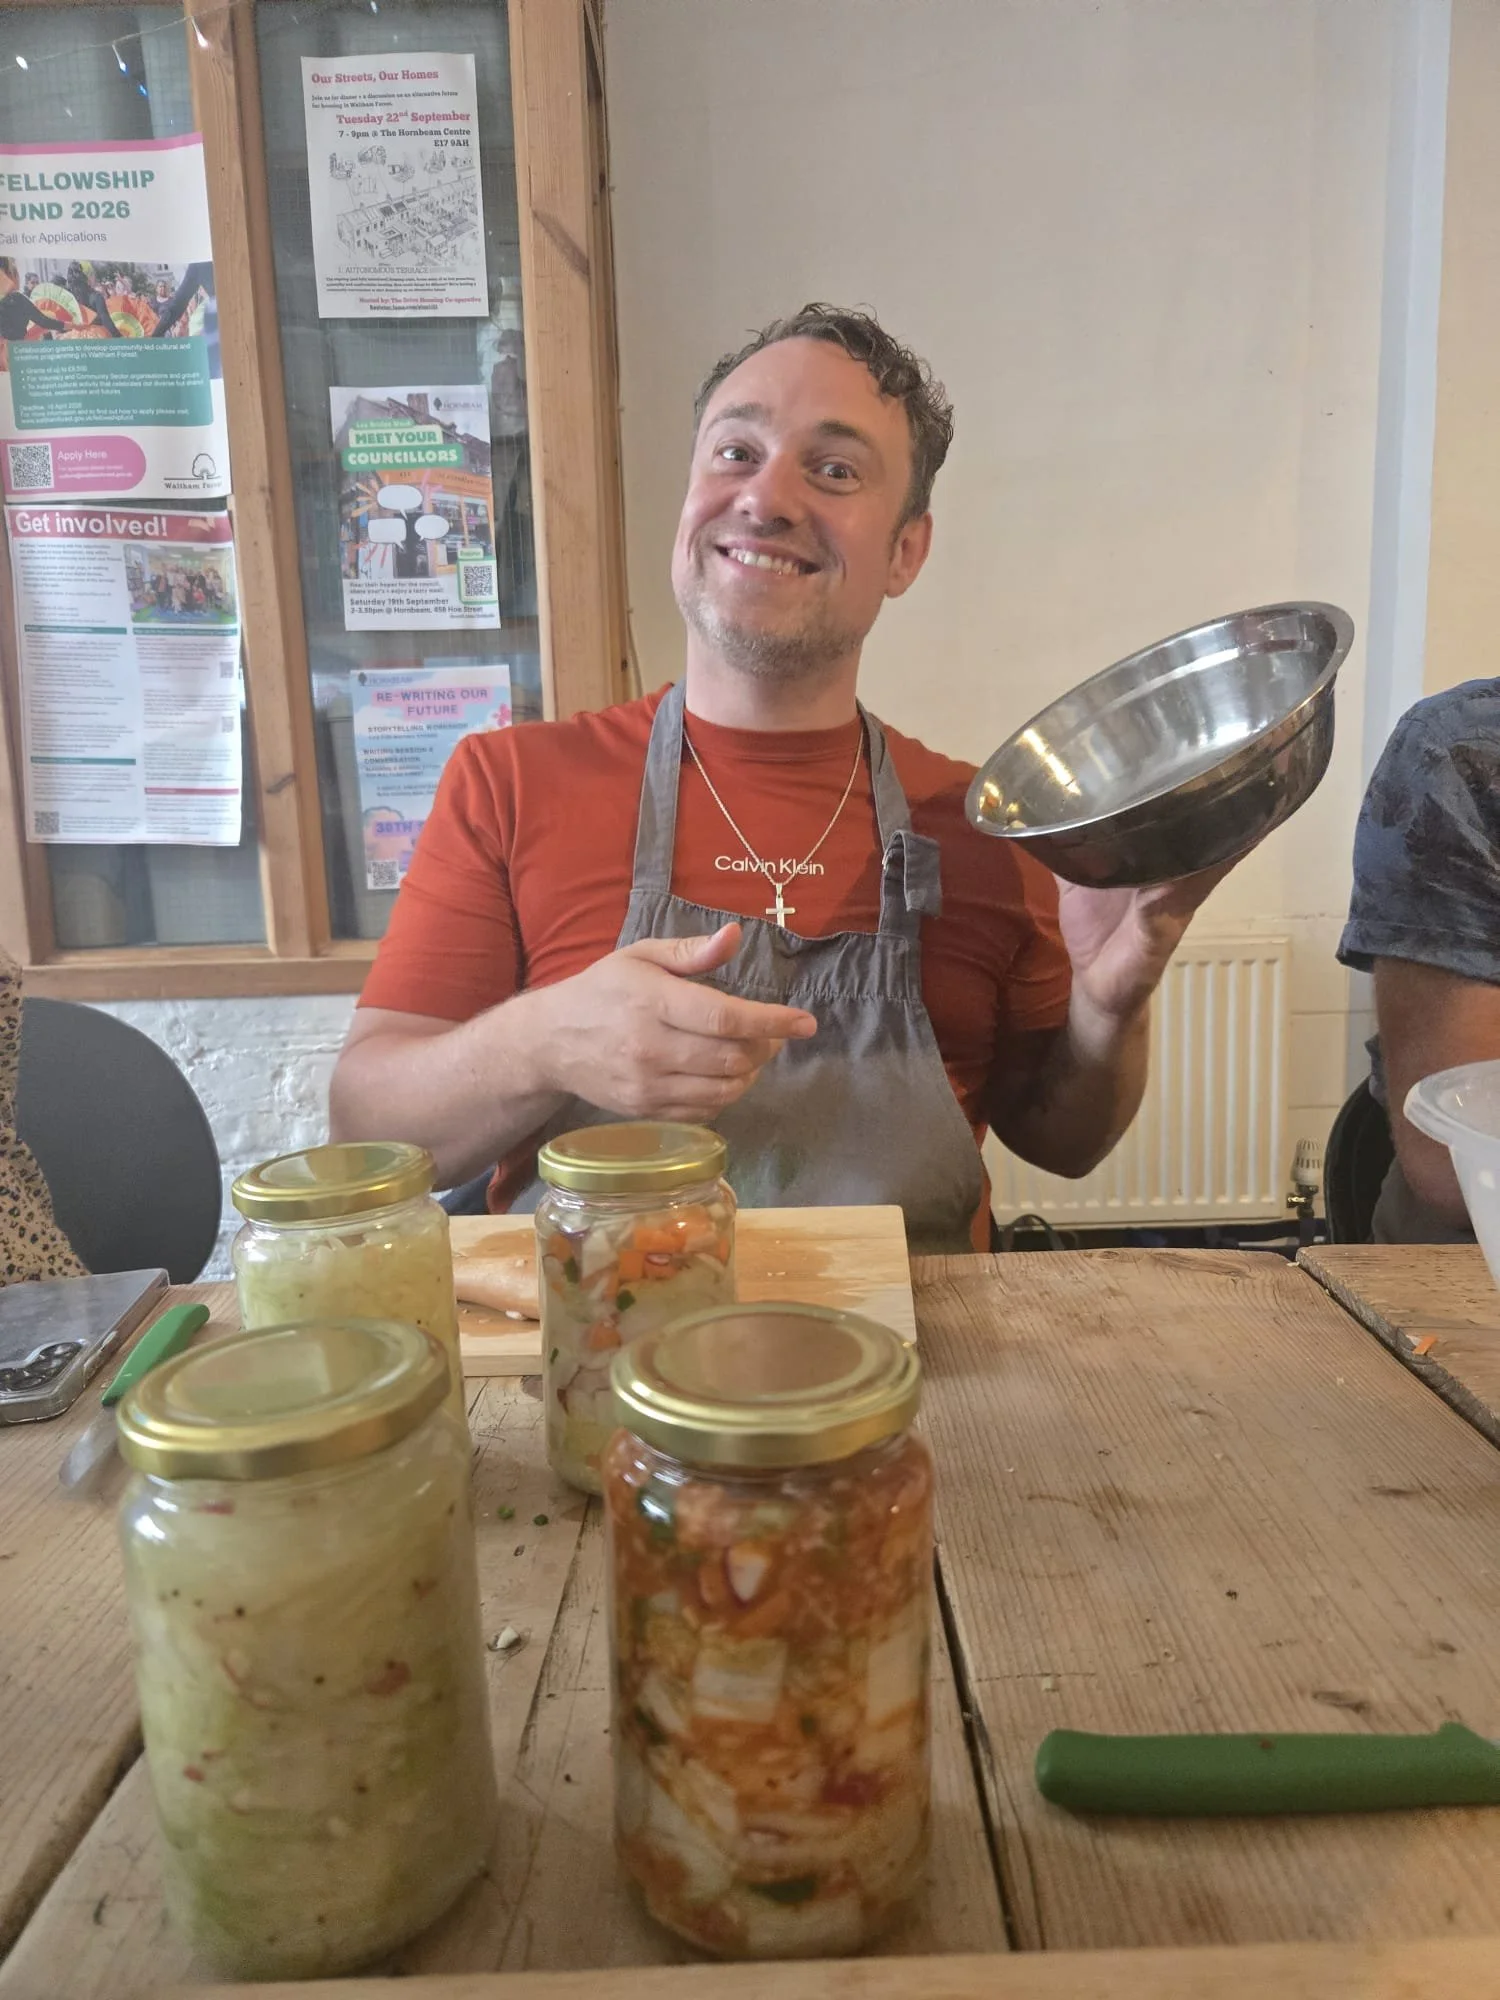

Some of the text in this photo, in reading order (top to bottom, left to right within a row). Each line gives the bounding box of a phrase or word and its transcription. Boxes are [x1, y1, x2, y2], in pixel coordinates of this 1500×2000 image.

[311, 69, 439, 84] Our Streets, Our Homes
[336, 114, 383, 126] Tuesday
[411, 110, 471, 124] September
[351, 130, 369, 139] 9pm
[371, 130, 379, 138] @
[380, 129, 397, 137] The
[399, 128, 441, 137] Hornbeam
[443, 127, 471, 136] Centre
[450, 139, 469, 147] 9AH
[71, 200, 130, 219] 2026
[21, 232, 36, 244] for
[39, 231, 107, 246] Applications
[180, 342, 191, 350] and
[355, 431, 438, 445] MEET YOUR
[57, 449, 108, 462] Apply Here
[348, 449, 458, 465] COUNCILLORS
[164, 481, 200, 489] Waltham
[15, 511, 168, 537] Get involved!
[350, 599, 385, 607] Saturday
[406, 598, 449, 607] September
[460, 689, 488, 699] OUR
[407, 704, 458, 716] FUTURE
[368, 725, 424, 733] STORYTELLING
[376, 821, 412, 833] 30TH
[714, 855, 825, 875] Calvin Klein
